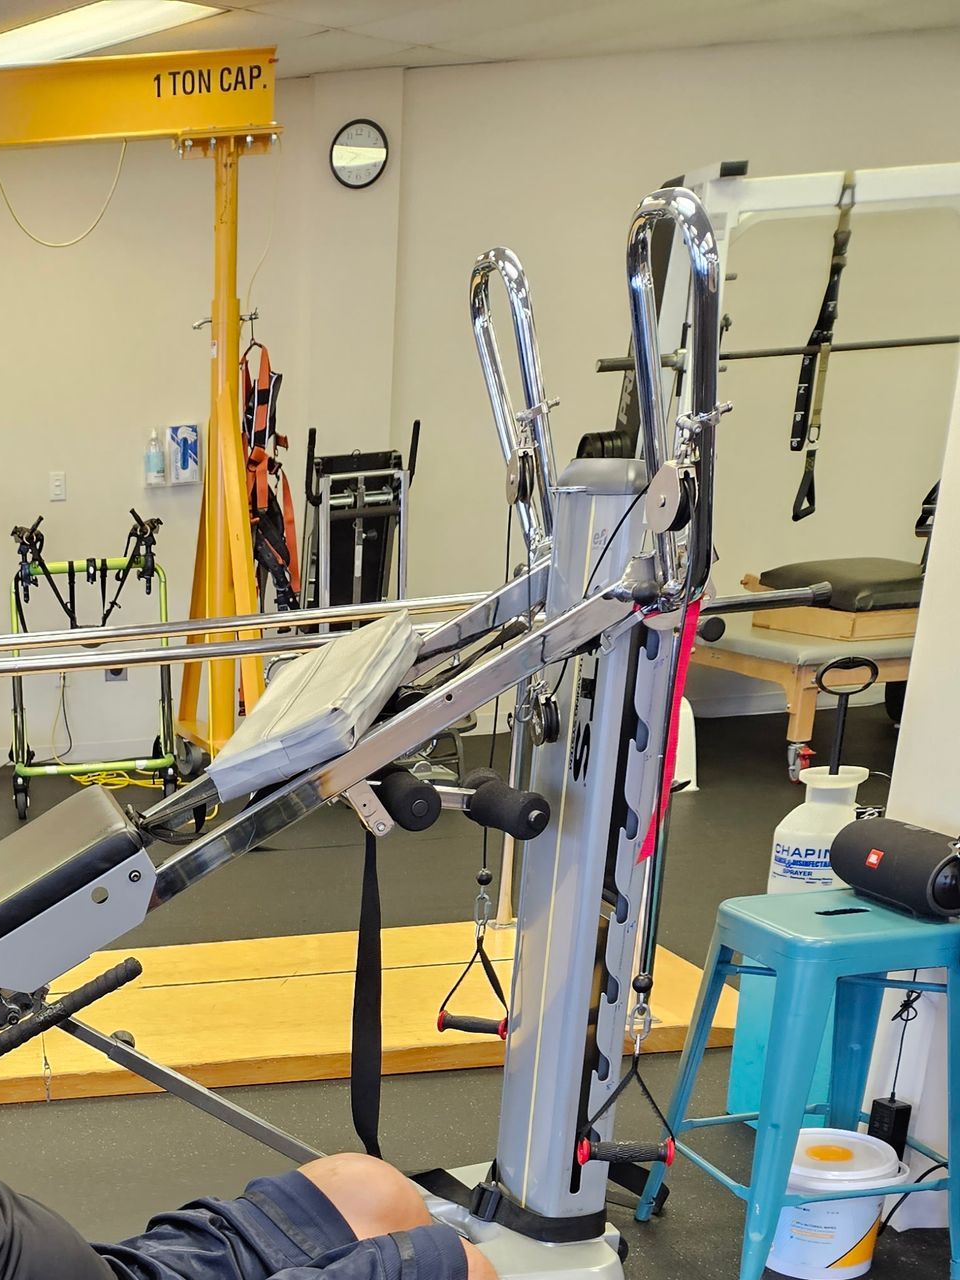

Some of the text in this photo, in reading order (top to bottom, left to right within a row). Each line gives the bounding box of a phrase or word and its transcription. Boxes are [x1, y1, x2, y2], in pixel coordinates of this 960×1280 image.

[153, 64, 267, 98] 1 TON CAP.
